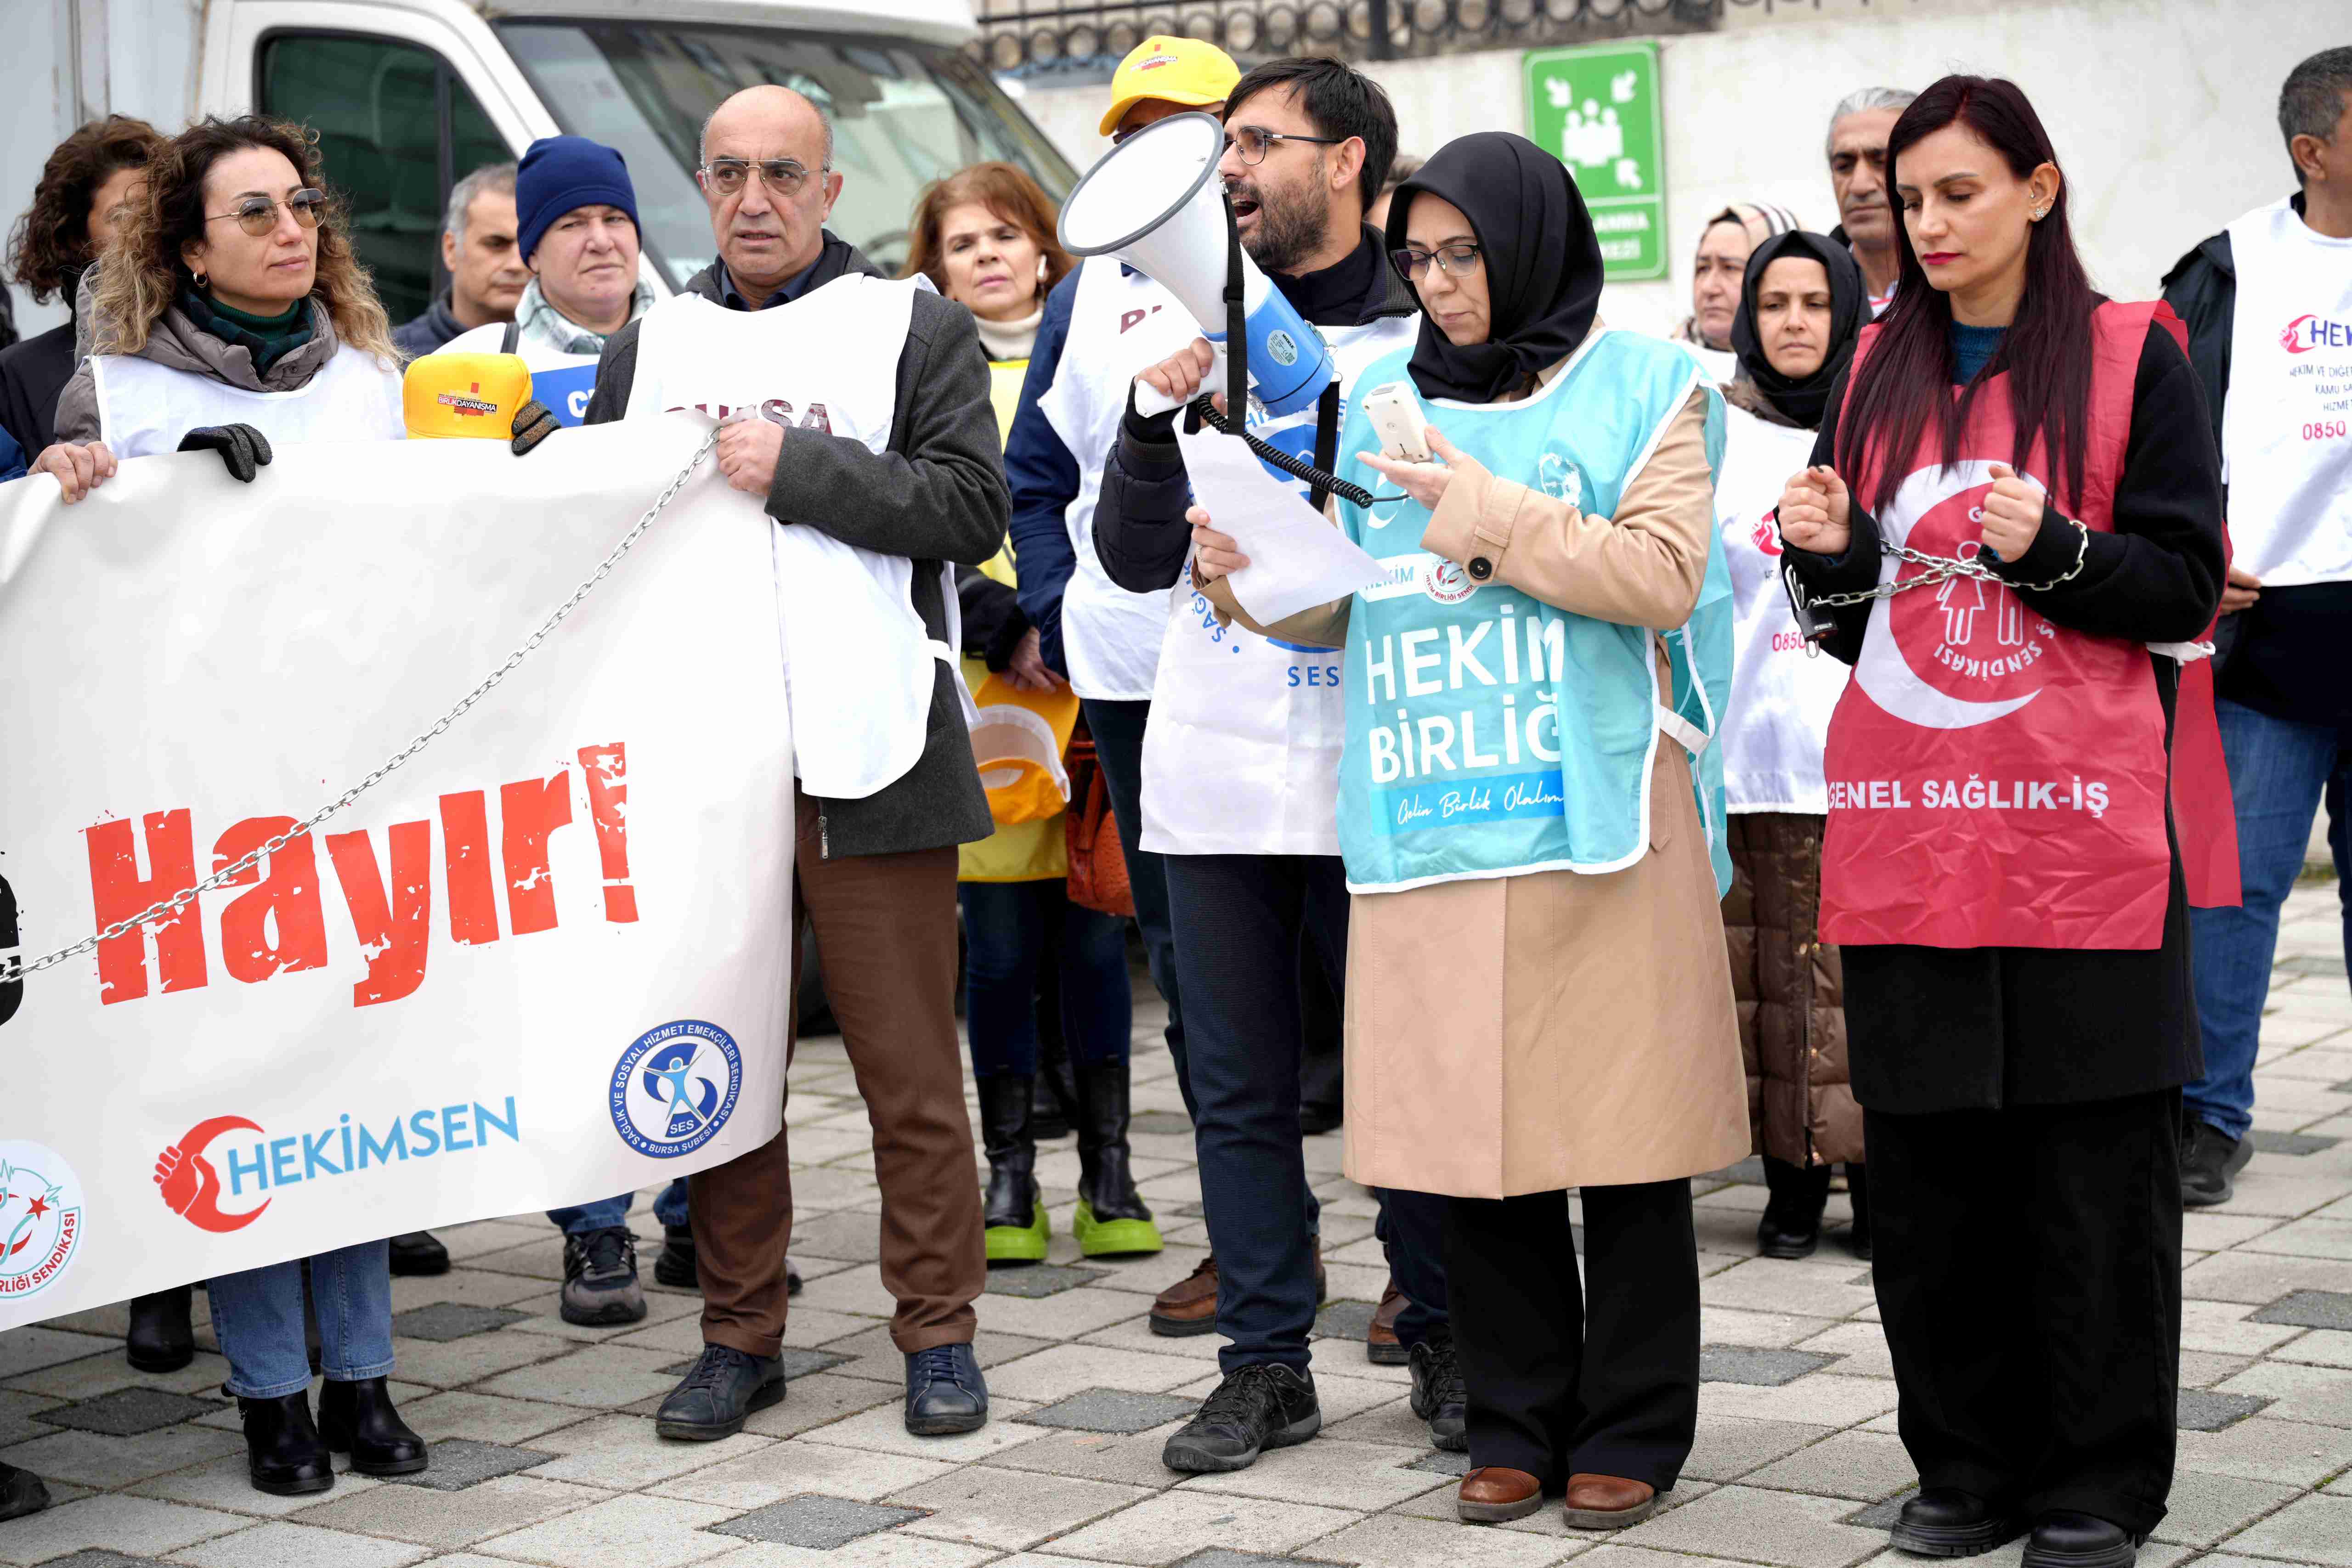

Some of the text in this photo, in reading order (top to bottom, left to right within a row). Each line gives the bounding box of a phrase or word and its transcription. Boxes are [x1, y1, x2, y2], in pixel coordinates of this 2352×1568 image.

[2303, 421, 2346, 440] 0850
[1366, 604, 1565, 705] HEKİM
[1933, 640, 2042, 681] SENDİKASI
[1288, 666, 1340, 687] SES
[1439, 787, 1490, 818] Birlik
[1828, 773, 2109, 818] GENEL SAĞLIK-İŞ
[86, 742, 639, 1007] Hayır!
[614, 1025, 739, 1145] SAĞLIK VE SOSYAL HİZMET EMEKÇİLERİ SENDİKASI
[228, 1096, 519, 1196] HEKİMSEN
[649, 1126, 713, 1154] BURSA ŞUBESİ
[670, 1120, 694, 1134] SES
[32, 1213, 75, 1284] SENDİKASI
